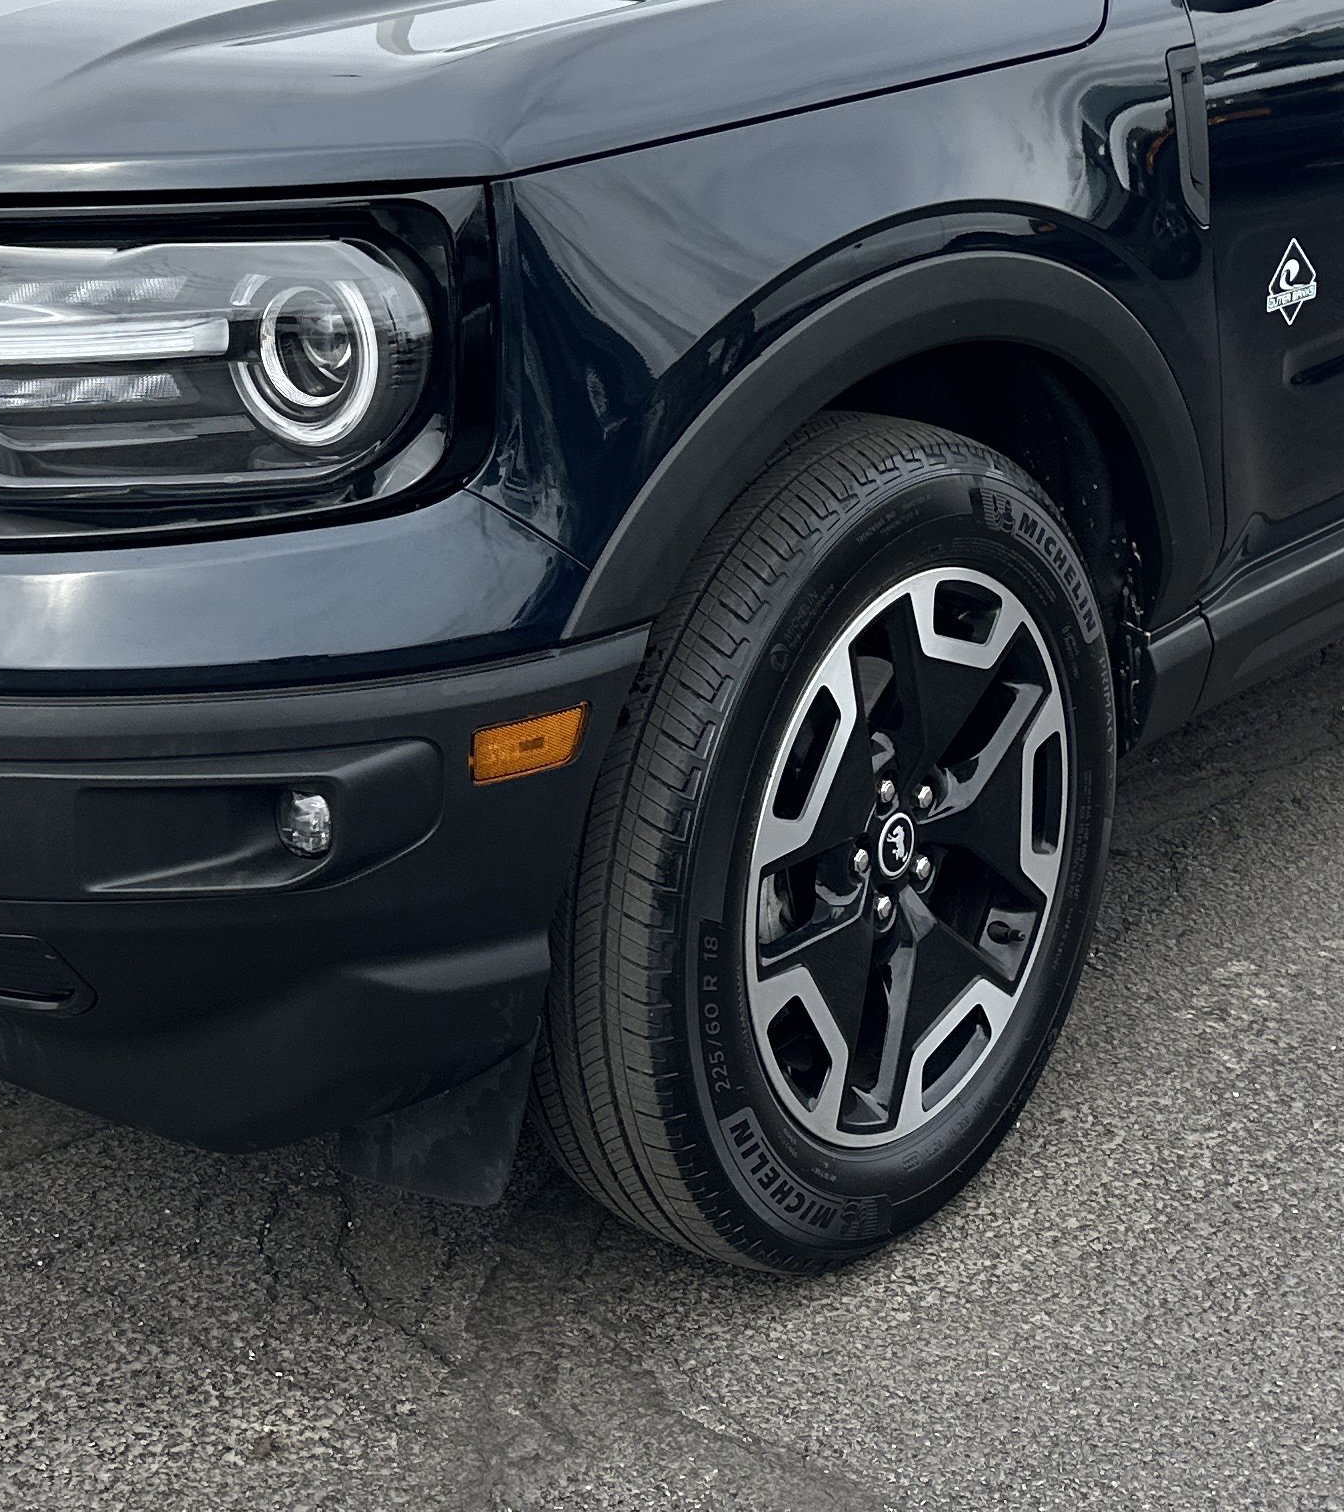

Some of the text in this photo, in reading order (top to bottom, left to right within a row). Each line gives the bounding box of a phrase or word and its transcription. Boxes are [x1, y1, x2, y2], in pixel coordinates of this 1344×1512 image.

[1018, 511, 1098, 634] MICHELIN
[703, 935, 732, 1094] 225/60 R 18
[729, 1118, 838, 1230] MICHELIN
